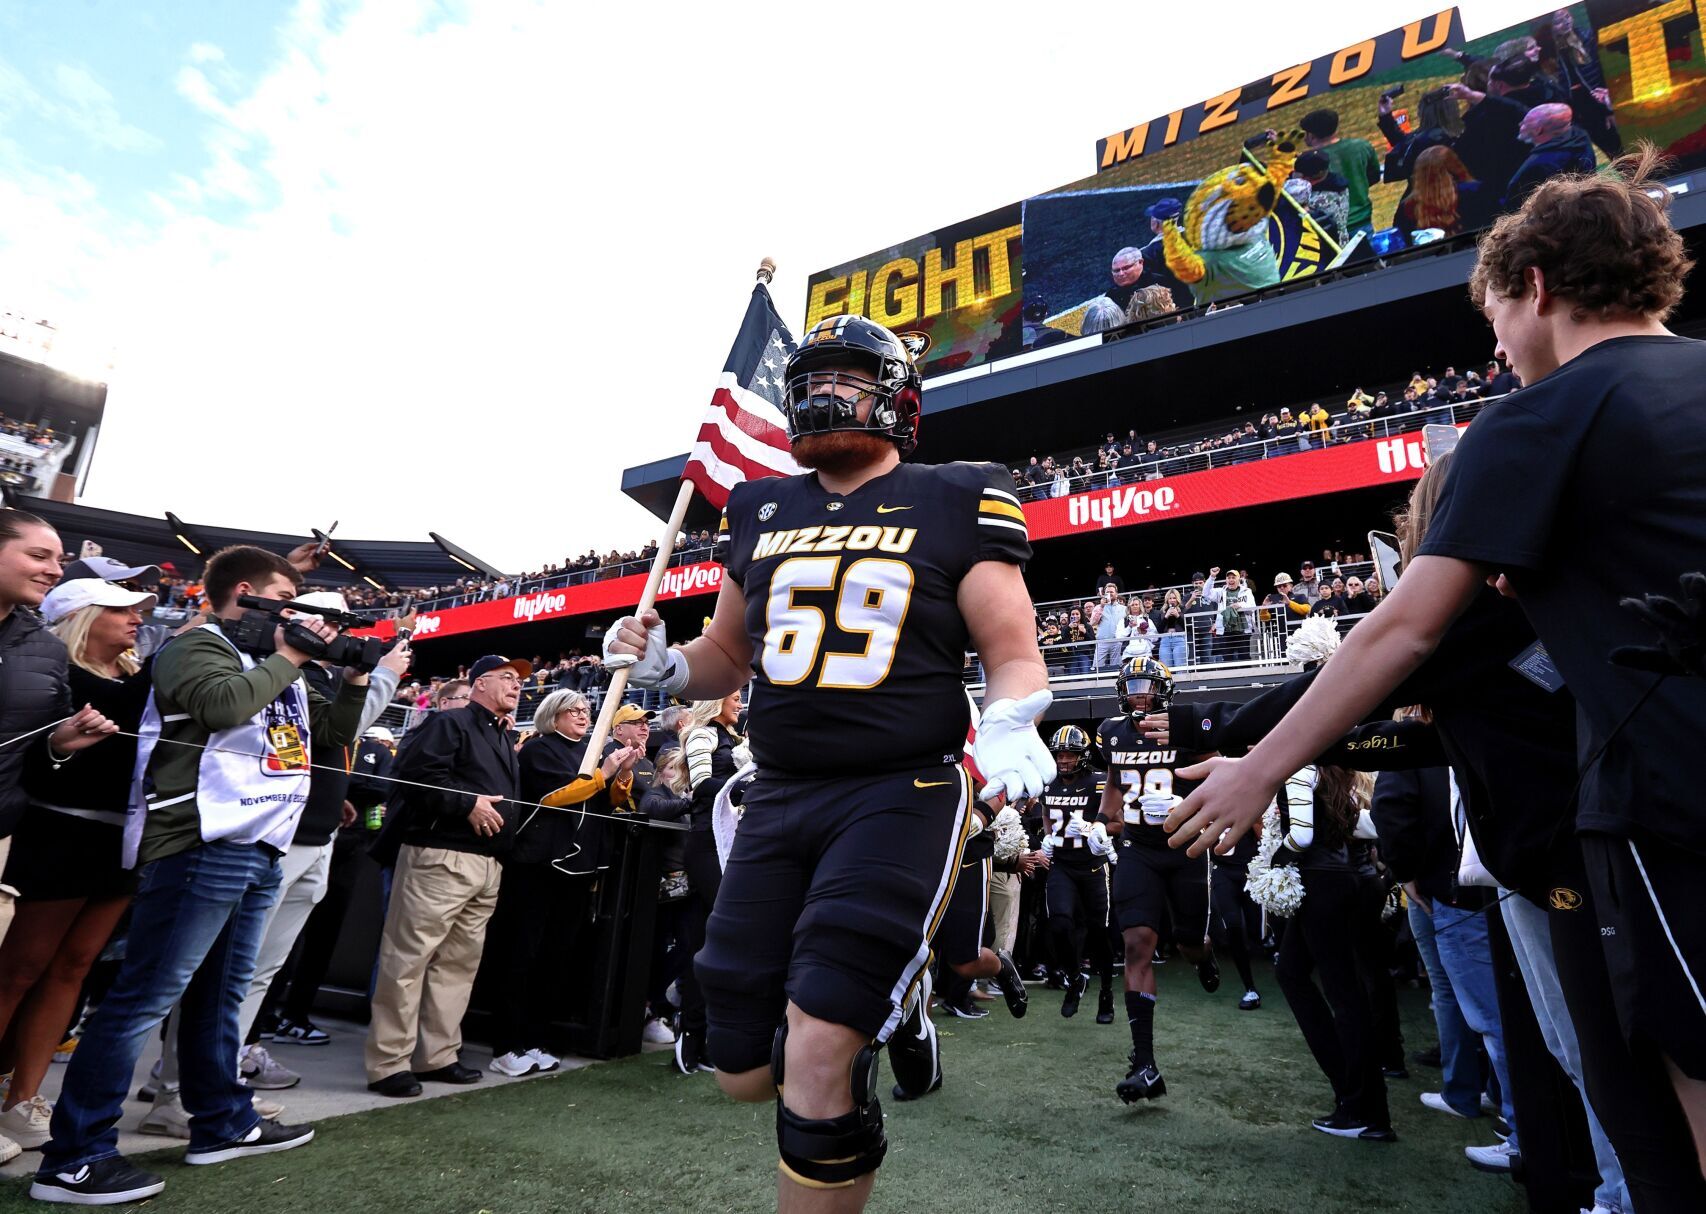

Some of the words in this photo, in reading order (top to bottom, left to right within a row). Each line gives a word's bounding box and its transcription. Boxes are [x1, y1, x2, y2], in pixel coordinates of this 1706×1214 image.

[1597, 0, 1706, 103] T
[1101, 8, 1453, 168] MIZZOU
[805, 223, 1022, 335] FIGHT
[1069, 485, 1175, 528] HyVee
[752, 525, 917, 561] MIZZOU
[513, 593, 566, 621] HyVee
[761, 555, 915, 688] 69
[1347, 735, 1406, 751] Tigers
[942, 753, 957, 763] 2XL
[1111, 750, 1177, 765] MIZZOU
[240, 793, 287, 806] NOVEMBER
[1045, 795, 1089, 806] MIZZOU
[1600, 926, 1616, 936] DSG
